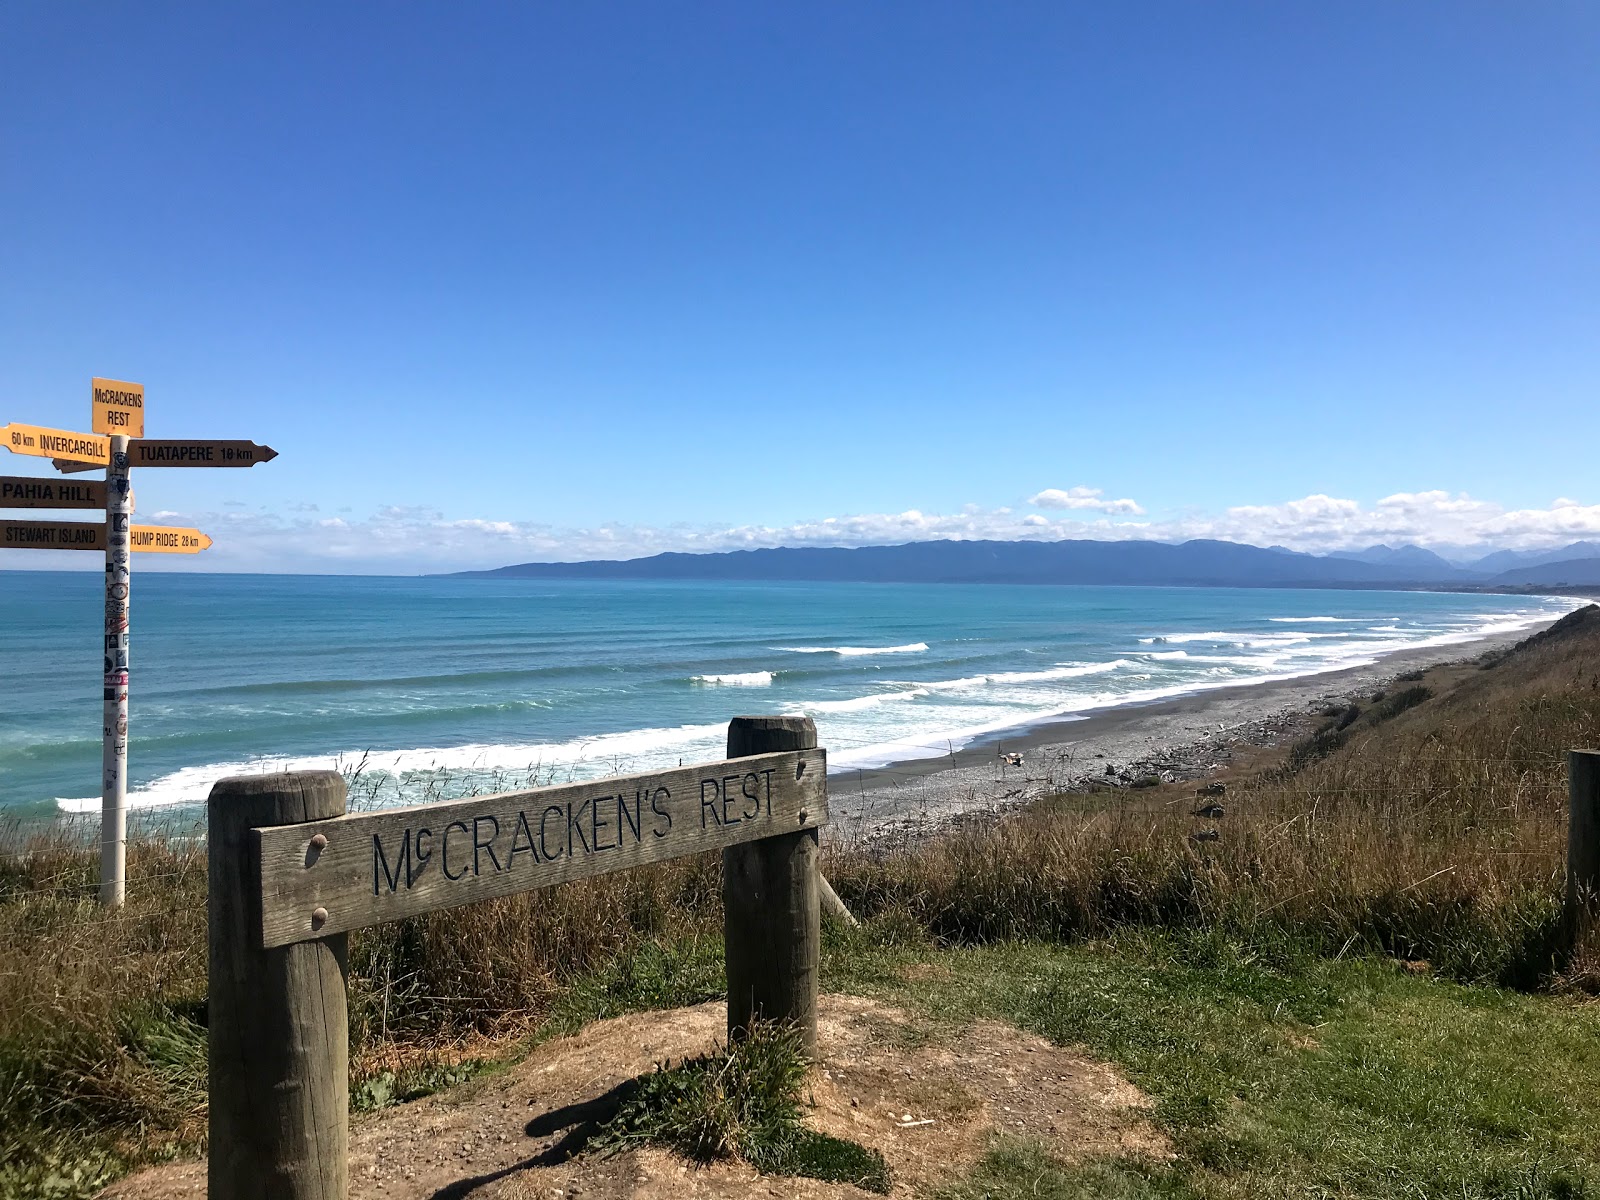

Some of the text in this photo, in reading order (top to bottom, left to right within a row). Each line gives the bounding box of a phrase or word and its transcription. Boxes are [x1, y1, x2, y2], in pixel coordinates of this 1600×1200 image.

[94, 388, 142, 408] McCRACKENS
[107, 410, 130, 427] REST
[12, 432, 106, 458] 60 km INVERCARGILL
[139, 446, 213, 461] TUATAPERE
[236, 448, 253, 460] km
[2, 483, 96, 501] PAHIA HILL
[6, 526, 96, 543] STEWART ISLAND
[130, 531, 199, 547] HUMP RIDGE 28 km
[700, 768, 777, 830] REST
